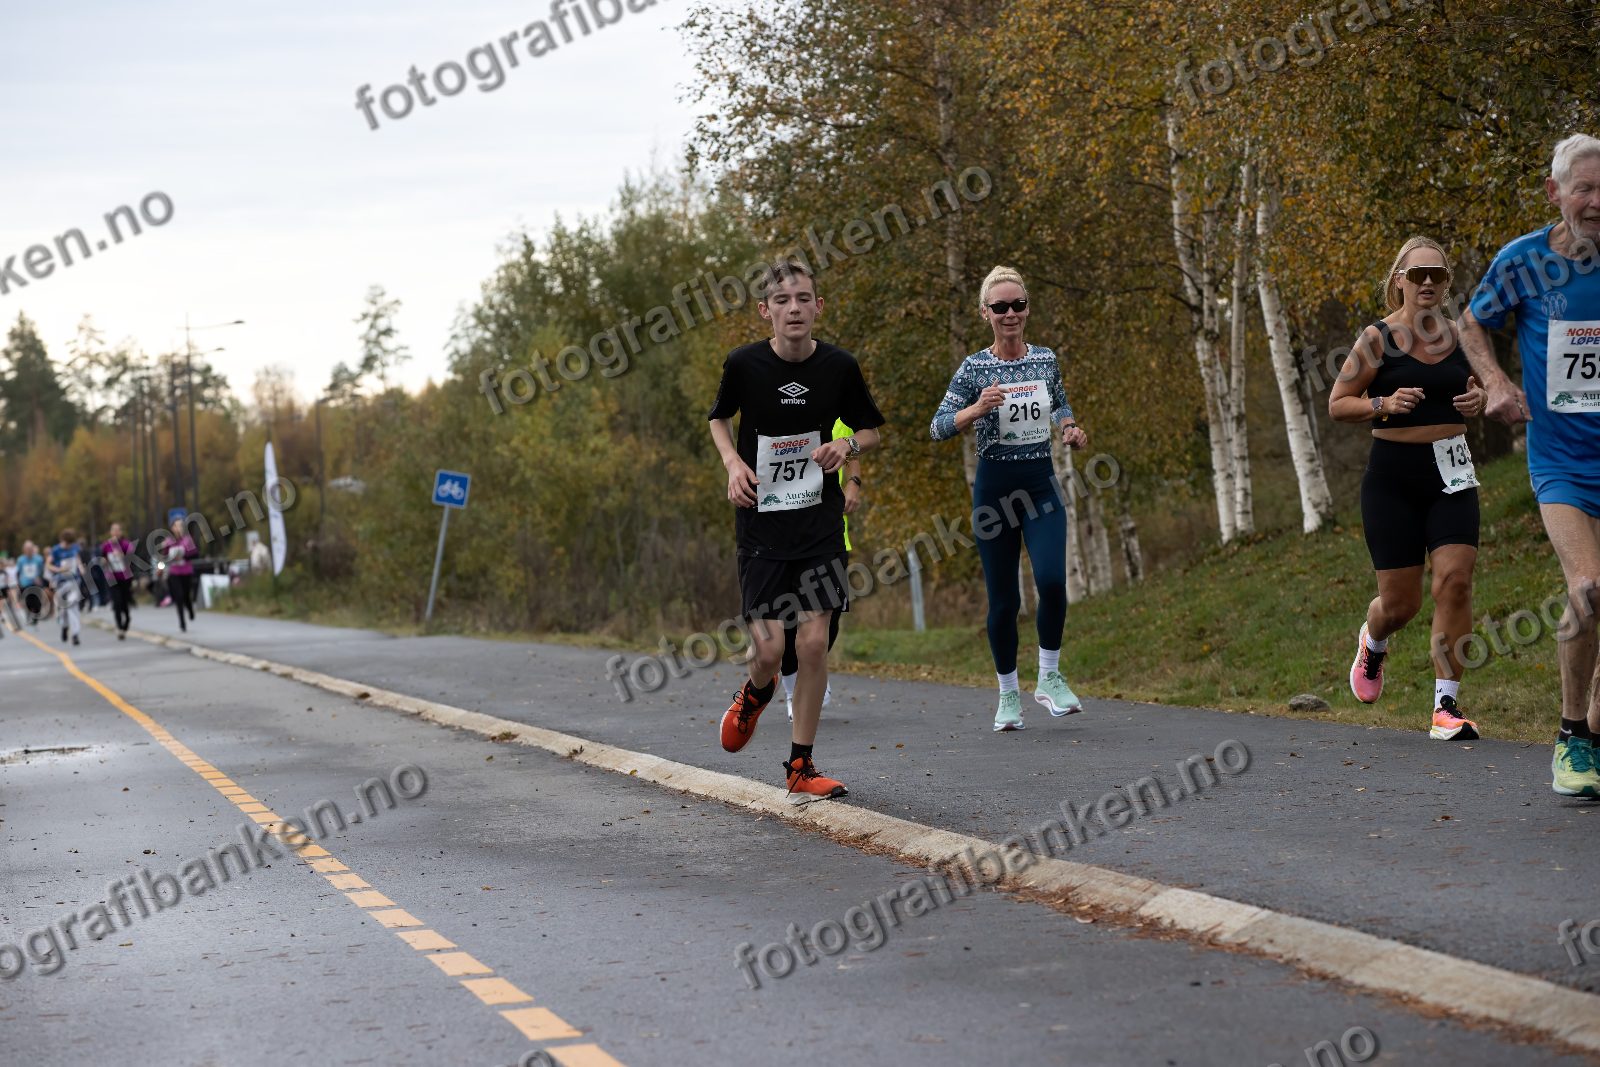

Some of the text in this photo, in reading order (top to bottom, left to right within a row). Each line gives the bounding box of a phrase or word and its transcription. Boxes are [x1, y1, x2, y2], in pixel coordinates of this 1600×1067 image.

[1563, 353, 1600, 379] 75
[1009, 384, 1038, 393] NORGES
[1012, 391, 1034, 399] LØPET
[781, 397, 806, 405] umbro
[1009, 402, 1040, 422] 216
[771, 438, 810, 449] NORGES
[775, 446, 804, 456] LØPET
[769, 458, 809, 482] 757
